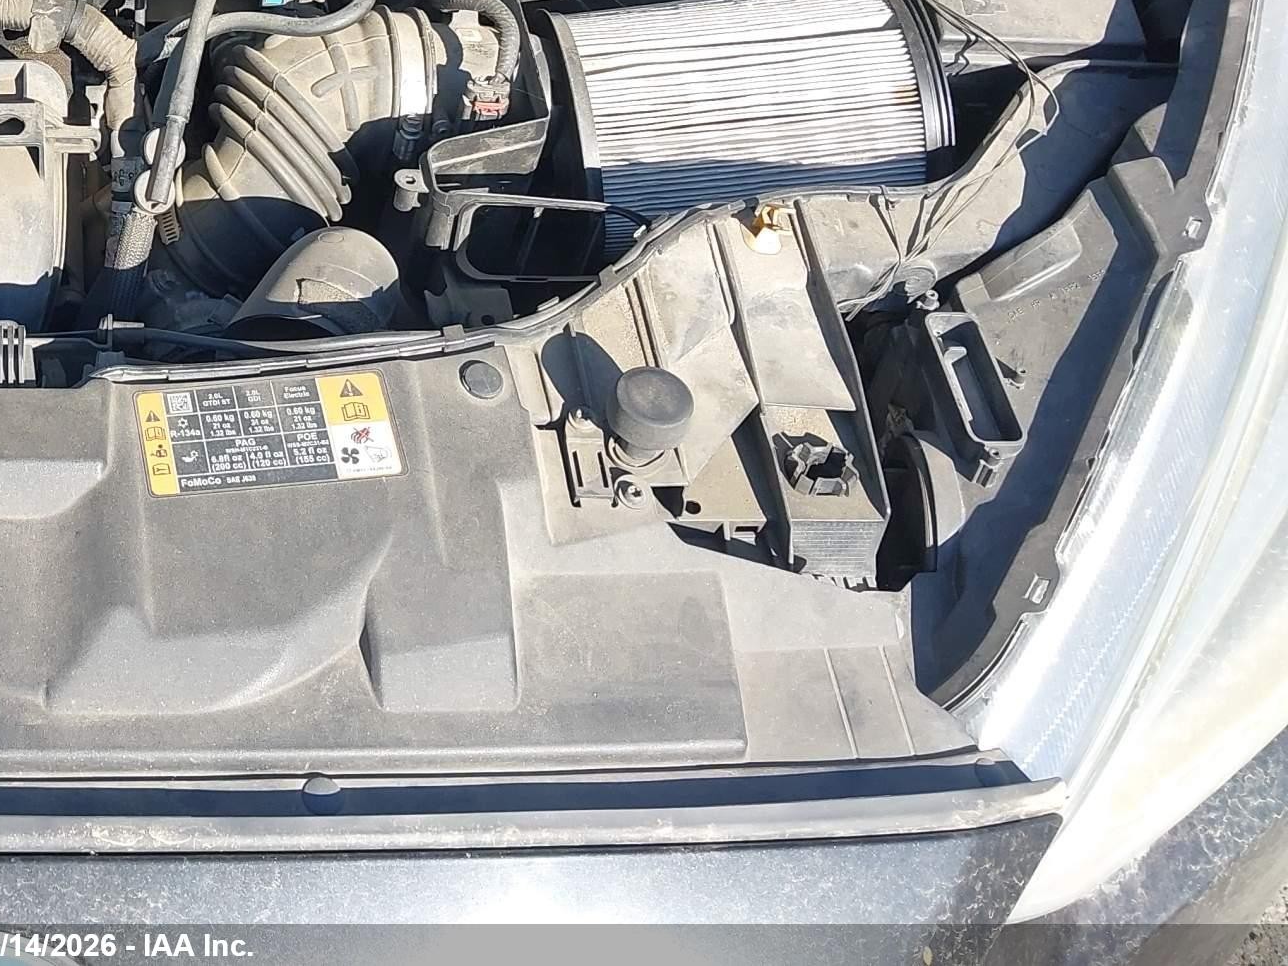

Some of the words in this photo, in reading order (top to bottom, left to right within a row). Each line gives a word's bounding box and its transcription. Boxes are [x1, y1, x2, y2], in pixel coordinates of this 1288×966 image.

[284, 391, 310, 399] Electric
[243, 410, 260, 419] 0.60
[262, 409, 272, 419] kg
[286, 406, 303, 416] 0.60
[304, 406, 316, 415] kg
[206, 414, 222, 423] 0.60
[224, 413, 235, 423] kg
[293, 415, 301, 423] 21
[213, 422, 220, 430] 21
[249, 426, 262, 434] 1.32
[263, 425, 274, 433] lbs
[292, 423, 305, 431] 1.32
[170, 428, 201, 438] R-134a
[296, 432, 318, 442] POE
[235, 438, 256, 447] PAG
[264, 450, 271, 459] fl
[273, 450, 284, 458] oz
[293, 447, 307, 456] 5.2
[308, 447, 315, 455] fl
[252, 459, 270, 469] (120
[273, 457, 286, 467] cc)
[296, 454, 314, 465] (155
[316, 453, 330, 464] cc)
[212, 462, 231, 473] (200
[232, 461, 247, 471] cc)
[181, 477, 222, 488] FoMoCo
[226, 476, 240, 484] SAE
